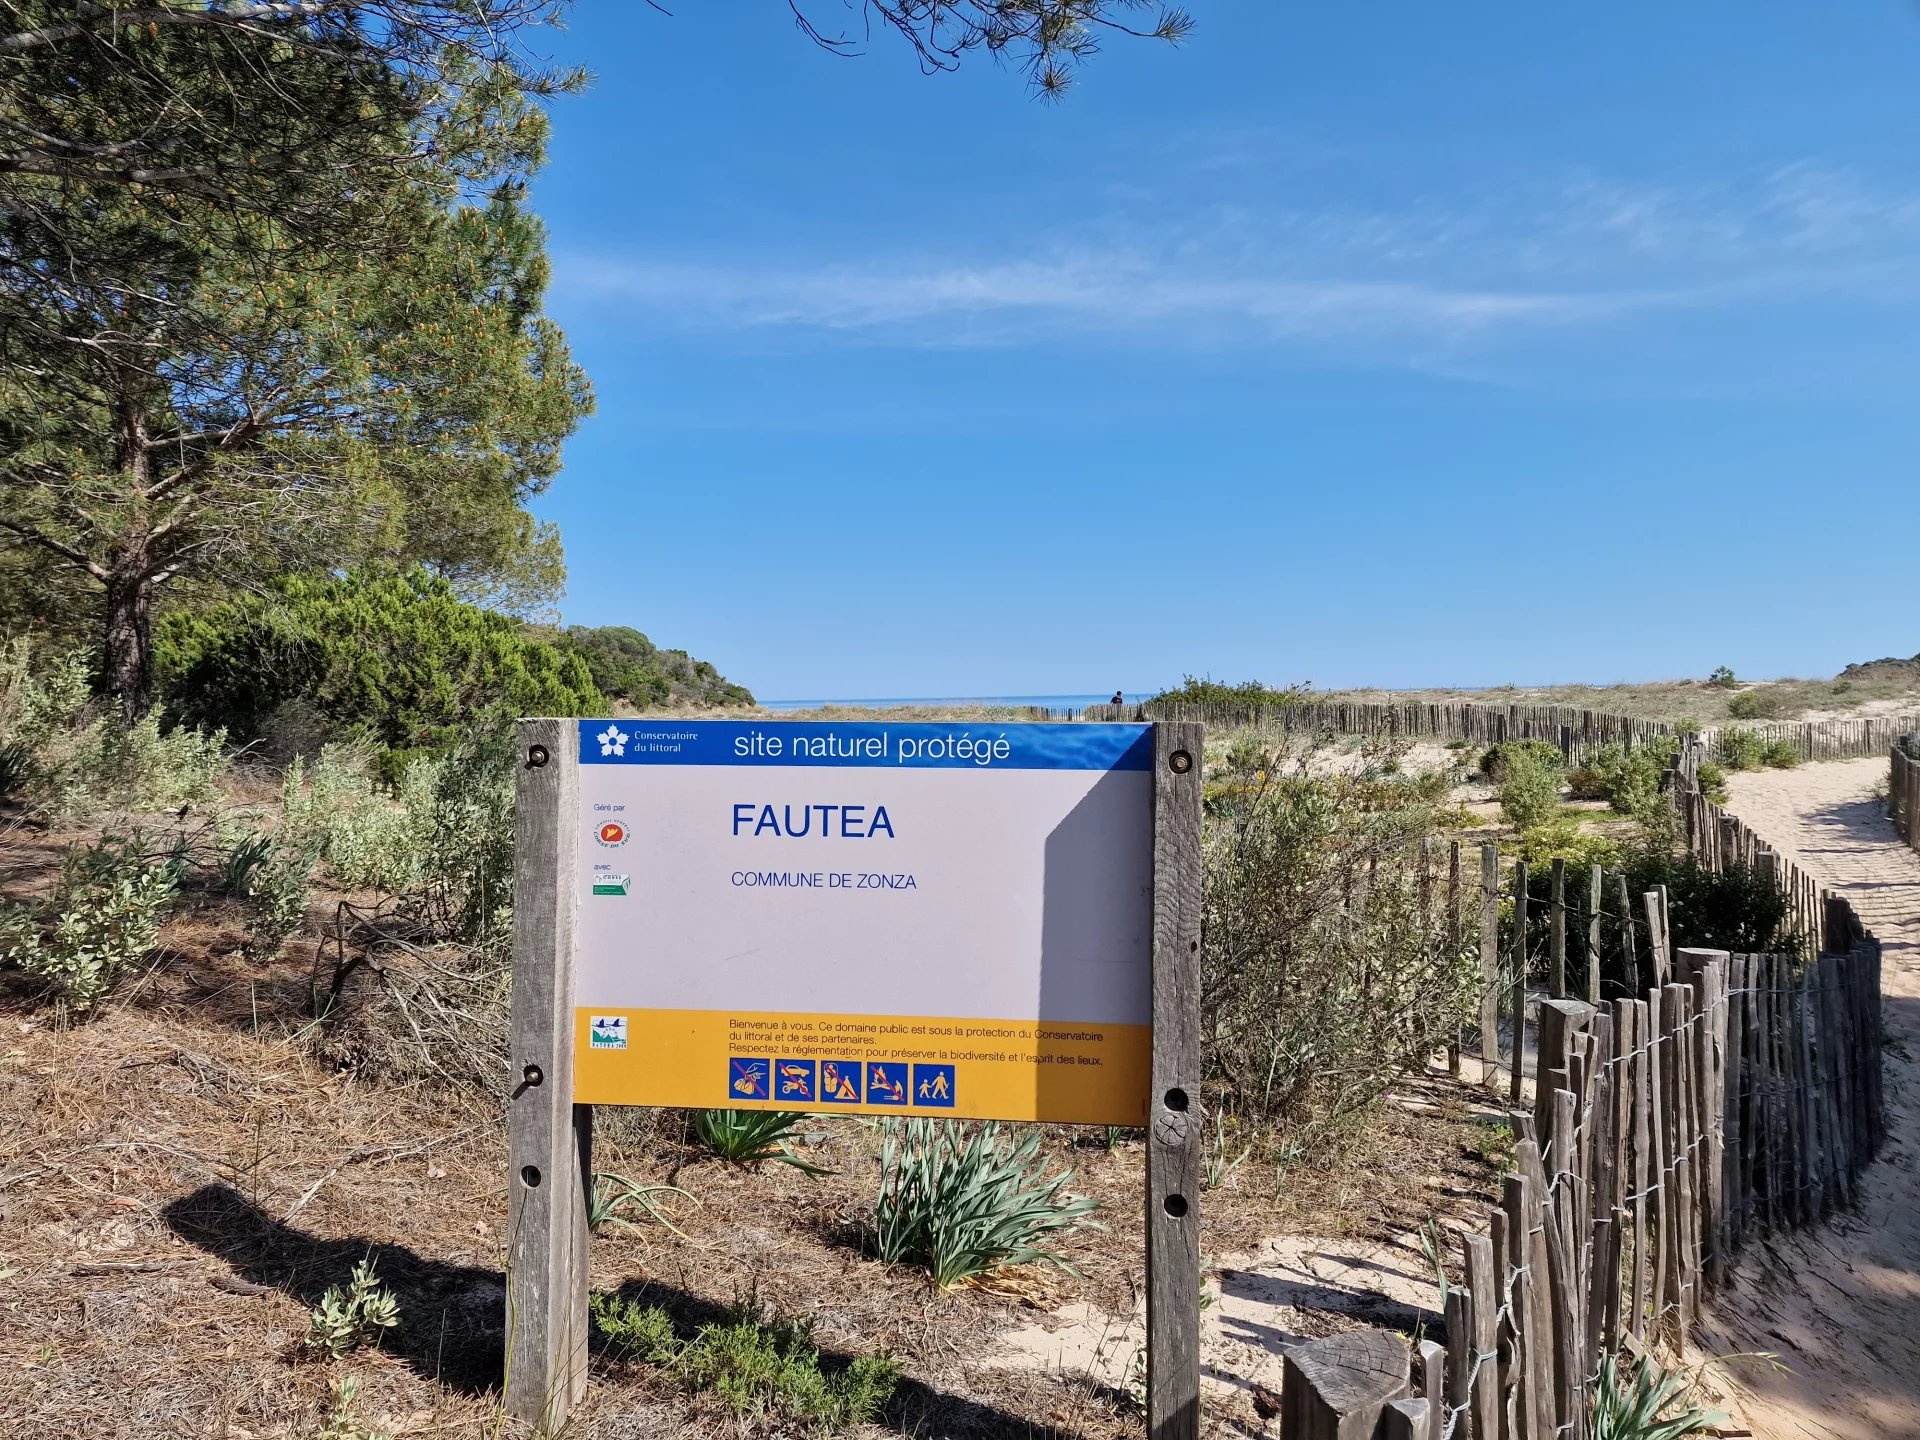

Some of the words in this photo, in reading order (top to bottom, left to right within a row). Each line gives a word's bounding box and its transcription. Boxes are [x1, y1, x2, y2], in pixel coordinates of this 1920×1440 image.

[634, 730, 698, 740] Conservatoire
[634, 743, 647, 752] du
[650, 743, 681, 752] littoral
[734, 731, 783, 757] site
[793, 731, 888, 758] naturel
[899, 732, 1010, 765] protégé
[593, 803, 611, 811] Géré
[733, 804, 895, 838] FAUTEA
[731, 871, 824, 888] COMMUNE
[829, 873, 852, 888] DE
[857, 873, 917, 890] ZONZA
[729, 1019, 779, 1030] Bienvenue
[781, 1020, 787, 1030] à
[789, 1023, 815, 1031] vous.
[818, 1022, 833, 1031] Ce
[835, 1022, 877, 1033] domaine
[879, 1024, 909, 1035] public
[911, 1026, 926, 1034] est
[928, 1027, 953, 1036] sous
[955, 1026, 963, 1036] la
[966, 1027, 1016, 1038] protection
[1018, 1029, 1031, 1039] du
[1034, 1029, 1104, 1041] Conservatoire
[729, 1031, 741, 1040] du
[744, 1032, 772, 1041] littoral
[775, 1033, 784, 1042] et
[787, 1033, 800, 1042] de
[802, 1035, 819, 1043] ses
[821, 1034, 877, 1045] partenaires.
[729, 1043, 779, 1054] Respectez
[781, 1044, 790, 1053] la
[792, 1044, 863, 1057] réglementation
[865, 1048, 888, 1057] pour
[891, 1048, 936, 1059] préserver
[939, 1050, 948, 1059] la
[950, 1050, 1006, 1062] biodiversité
[1008, 1053, 1017, 1062] et
[1020, 1053, 1053, 1064] l'esprit
[1056, 1054, 1075, 1065] des
[1078, 1055, 1103, 1066] lieux.
